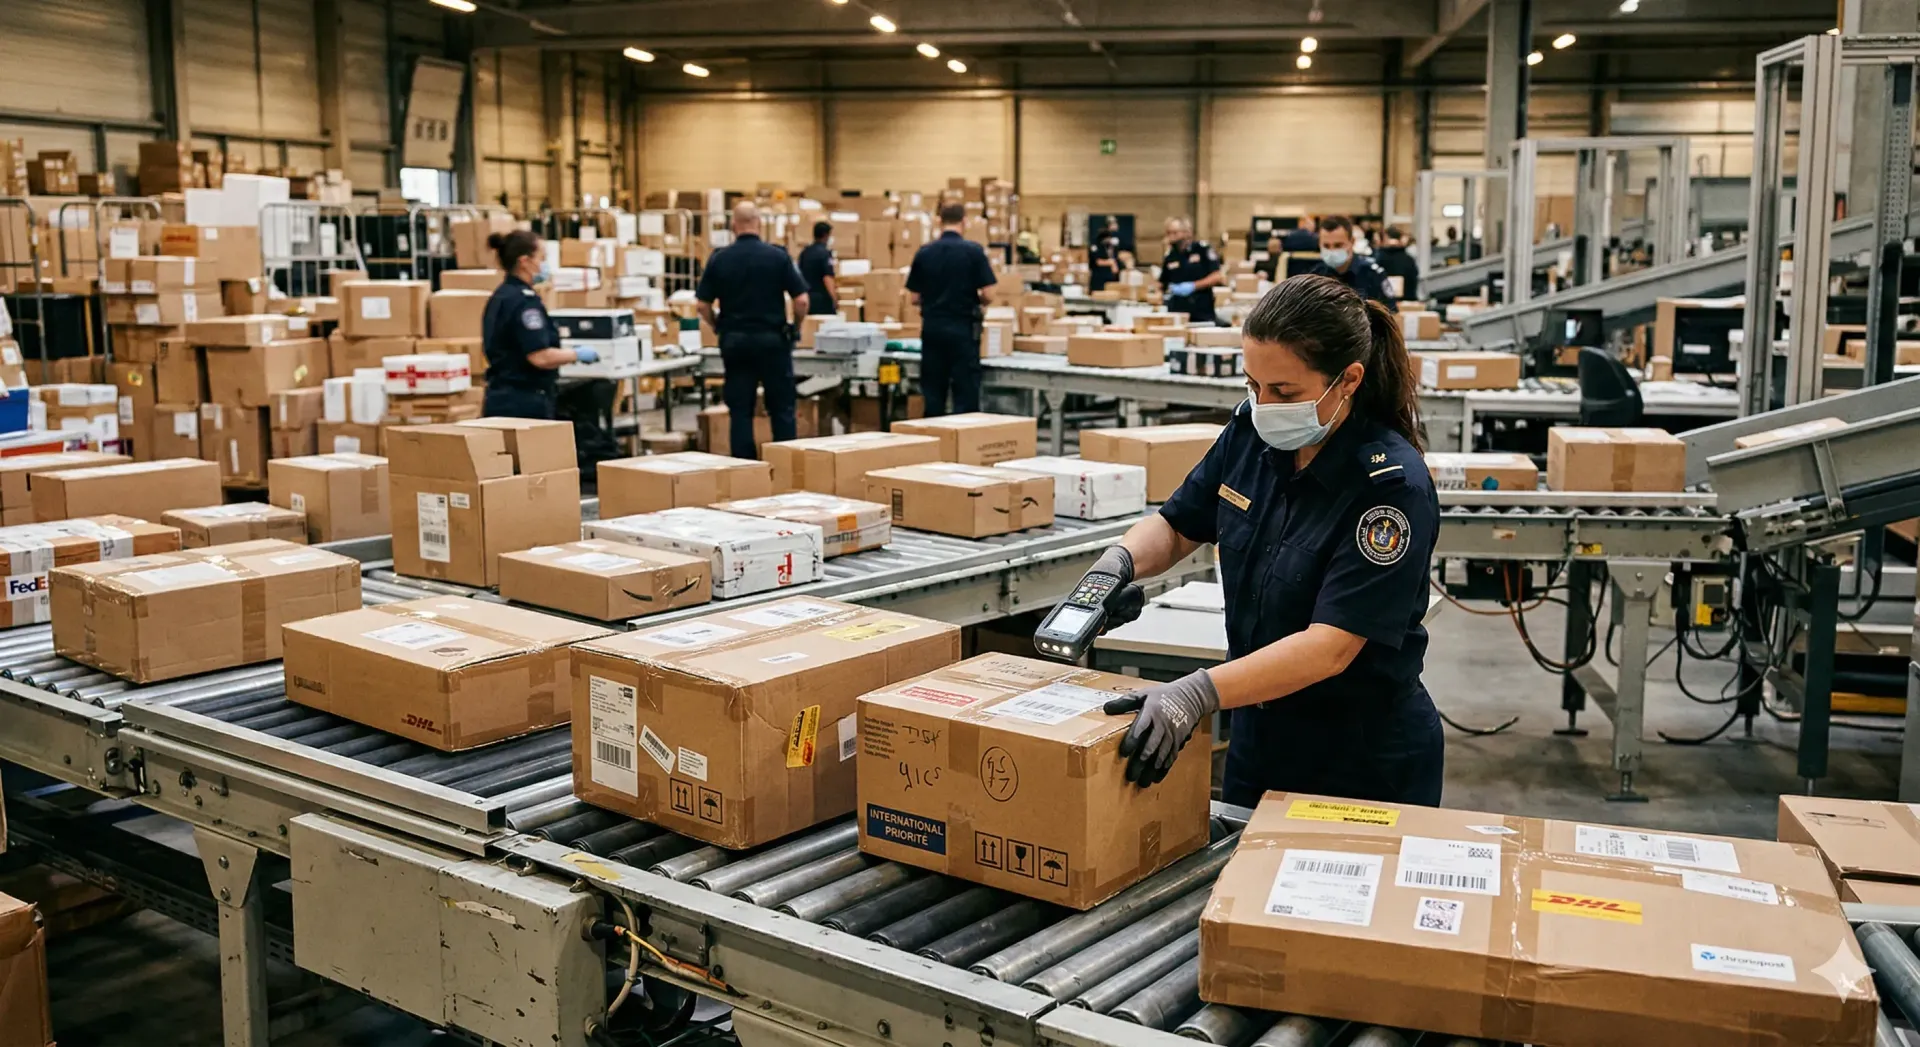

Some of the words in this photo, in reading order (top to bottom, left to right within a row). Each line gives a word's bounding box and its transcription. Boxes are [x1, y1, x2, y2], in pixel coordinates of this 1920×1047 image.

[10, 576, 48, 595] FedE
[402, 713, 441, 735] DHL
[869, 808, 944, 836] INTERNATIONAL
[885, 825, 929, 846] PRIORITÉ
[1547, 894, 1626, 913] DHL
